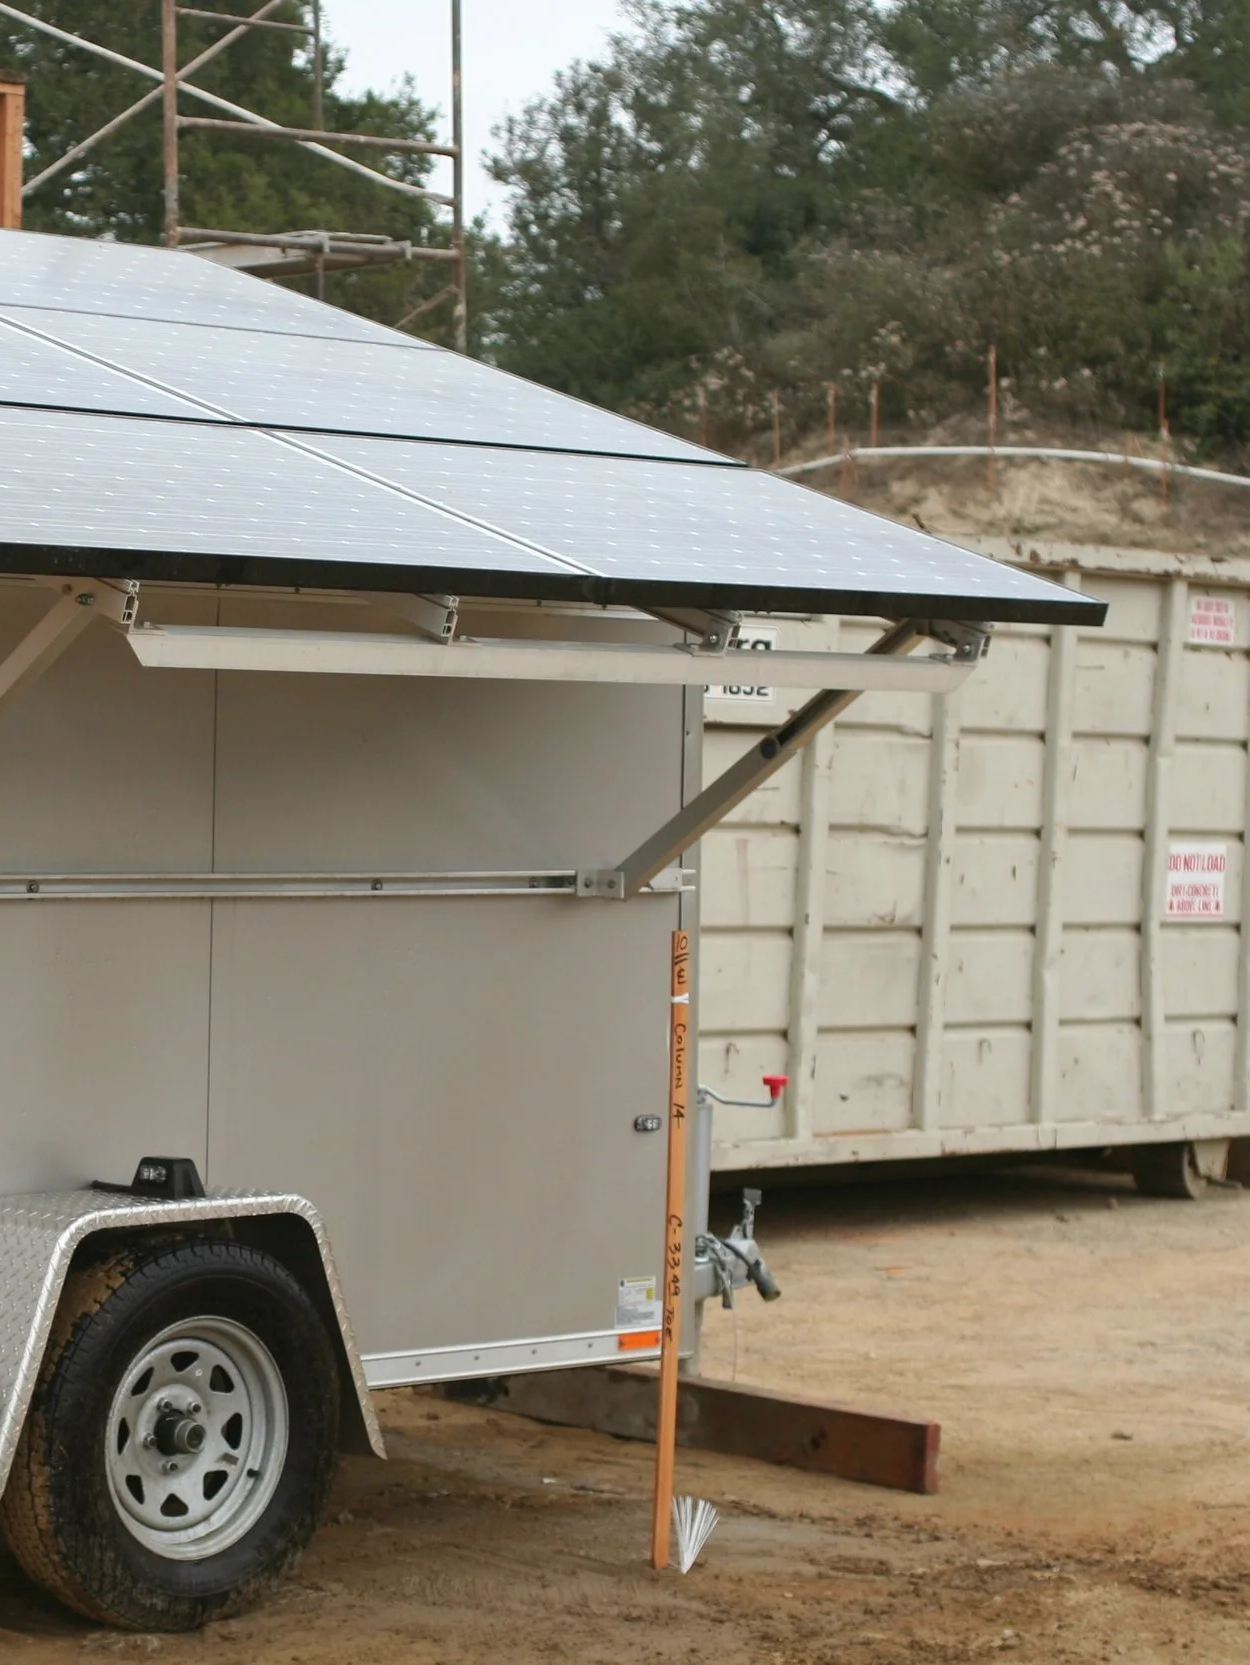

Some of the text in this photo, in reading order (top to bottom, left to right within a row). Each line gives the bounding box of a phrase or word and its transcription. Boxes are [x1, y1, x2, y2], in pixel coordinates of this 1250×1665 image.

[1170, 854, 1225, 872] DO NOT LOAD
